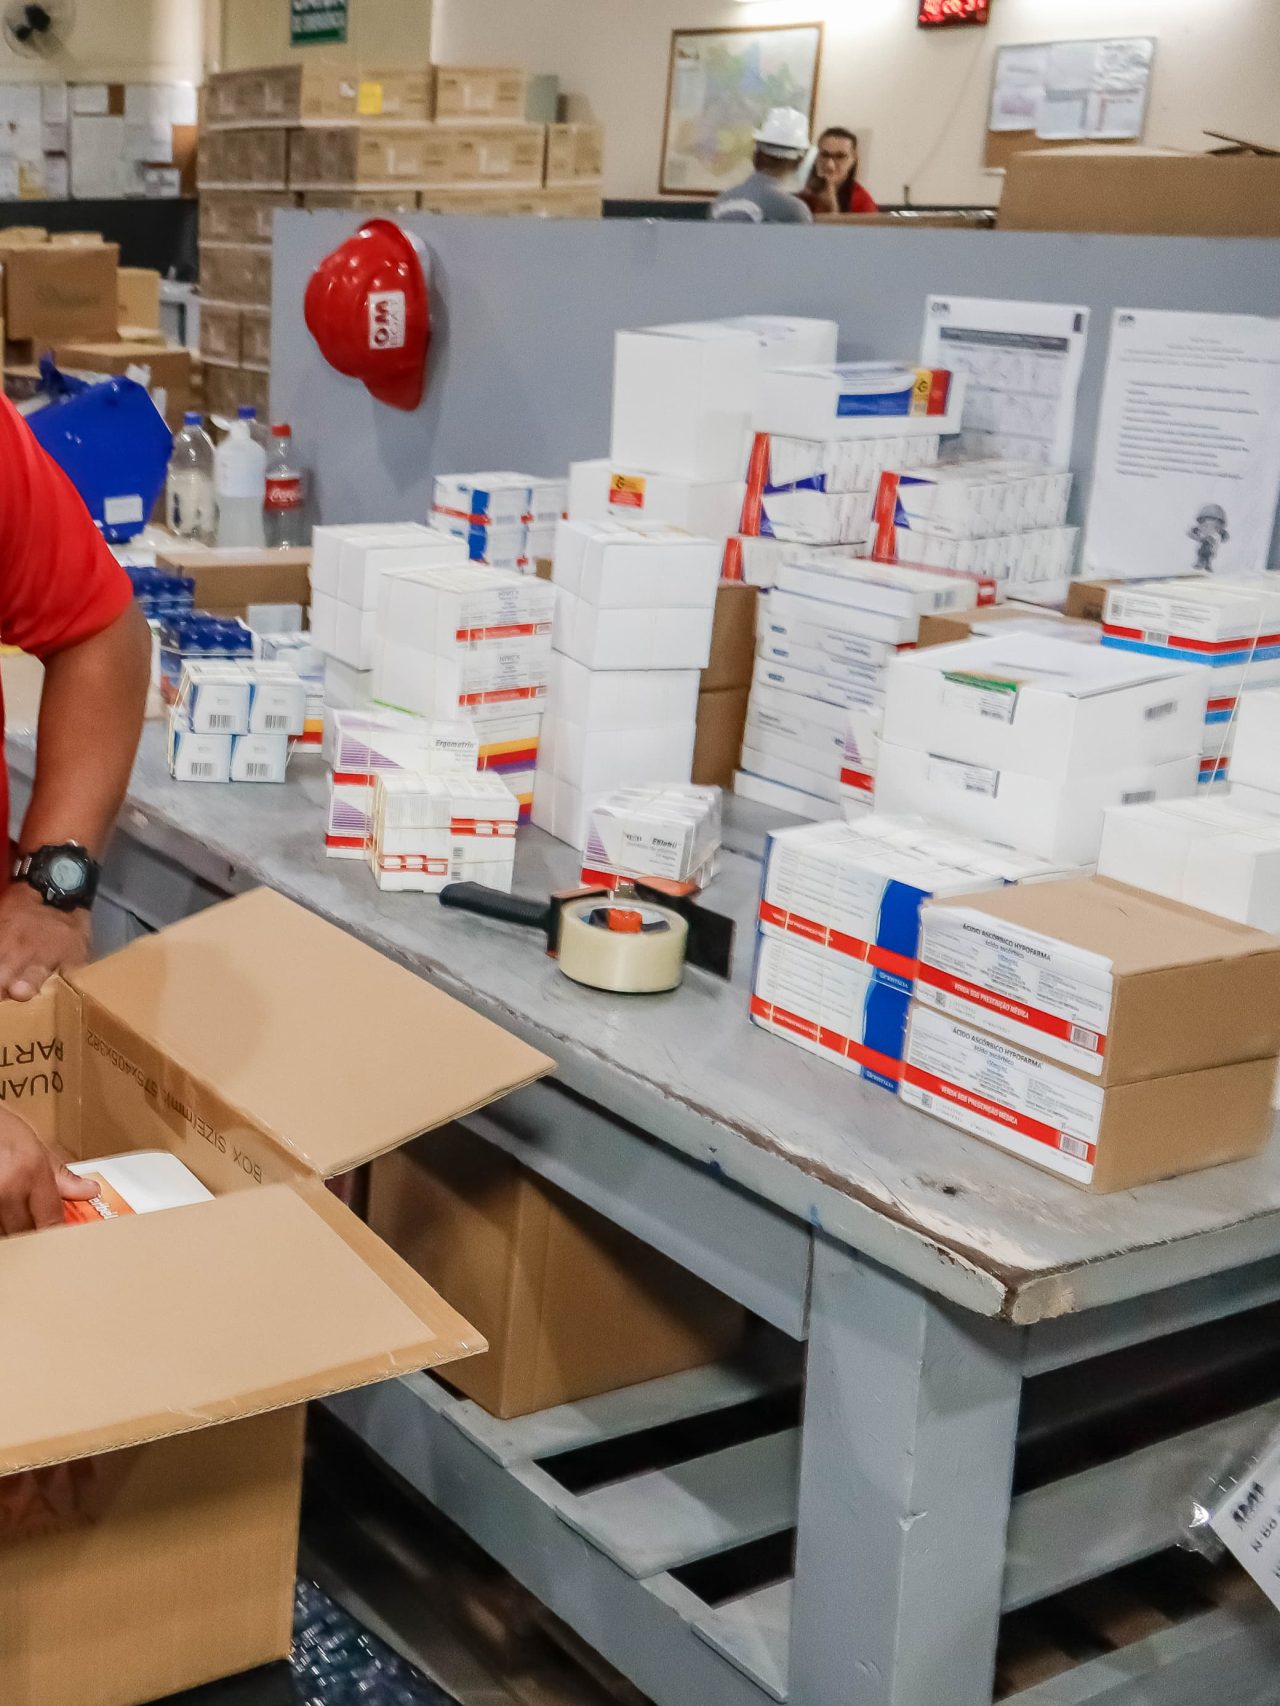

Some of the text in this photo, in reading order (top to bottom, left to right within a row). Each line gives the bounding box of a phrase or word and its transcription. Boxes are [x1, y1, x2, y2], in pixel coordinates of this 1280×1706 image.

[374, 300, 389, 346] OM
[1014, 941, 1052, 961] HYPOFARMA
[232, 1146, 263, 1185] BOX
